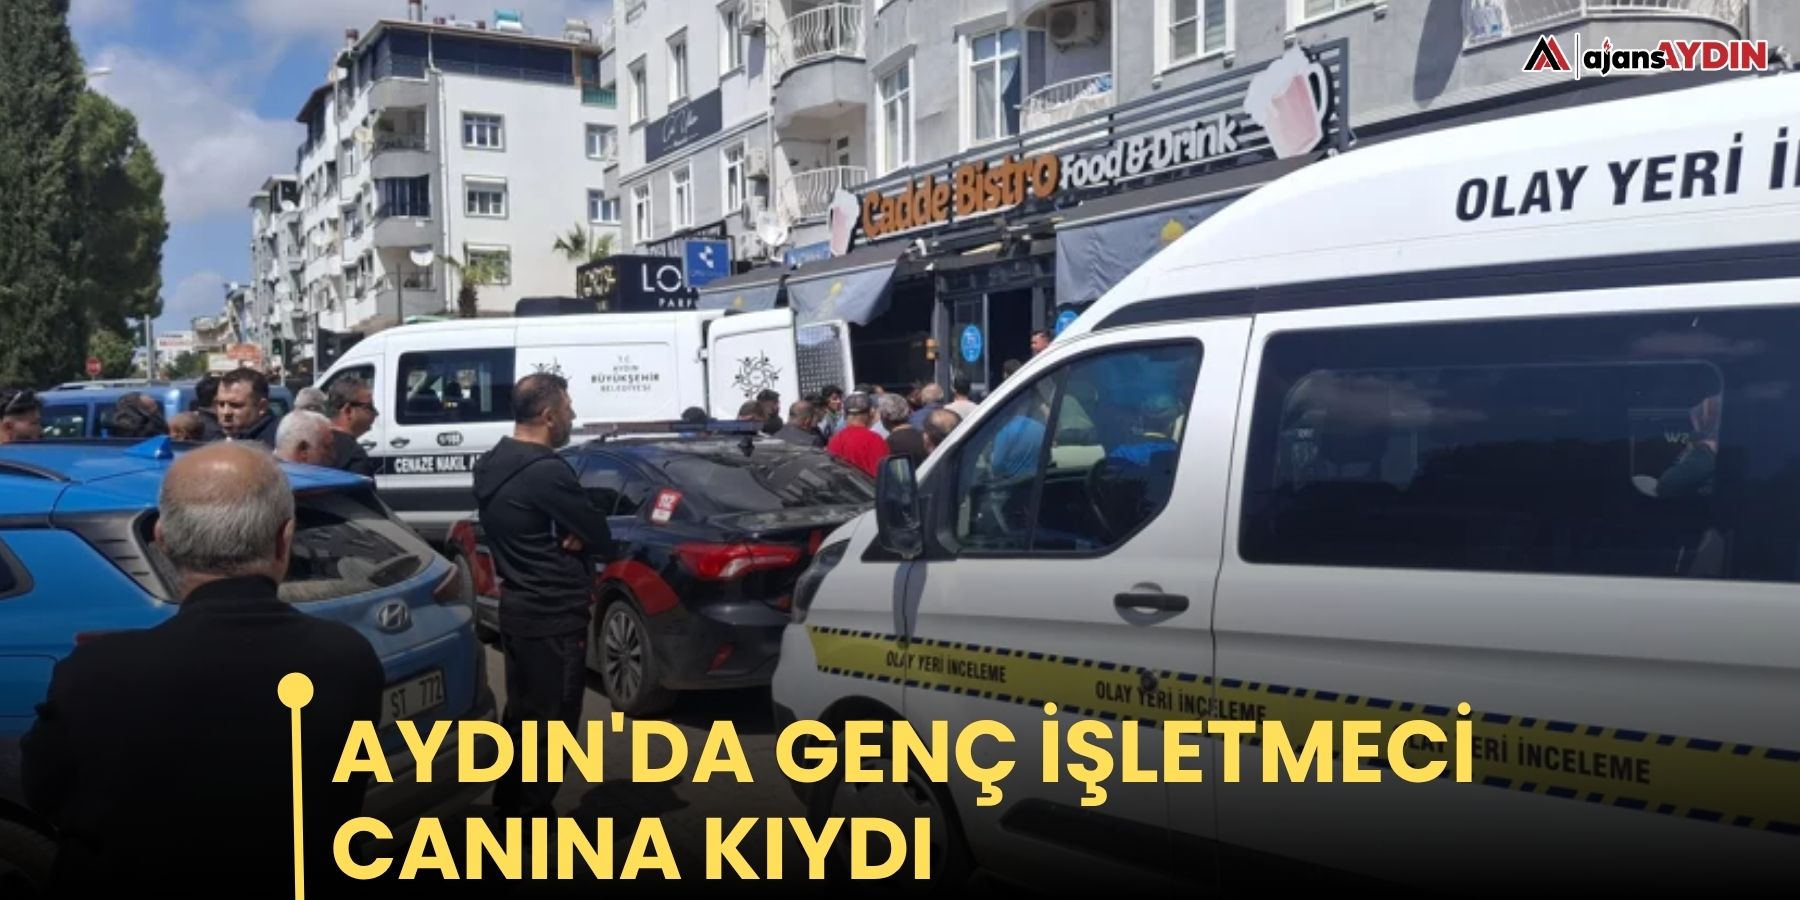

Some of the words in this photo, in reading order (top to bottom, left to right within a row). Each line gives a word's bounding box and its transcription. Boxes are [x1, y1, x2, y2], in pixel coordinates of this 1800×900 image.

[863, 175, 950, 239] Cadde
[955, 152, 1060, 215] Bistro
[1455, 165, 1588, 222] OLAY
[1608, 131, 1743, 206] YERİ
[394, 456, 434, 473] CENAZE
[391, 688, 405, 718] ST
[420, 675, 442, 706] 772
[1095, 680, 1132, 703] OLAY
[1472, 734, 1508, 764] ERİ
[1517, 736, 1651, 784] İNCELEME
